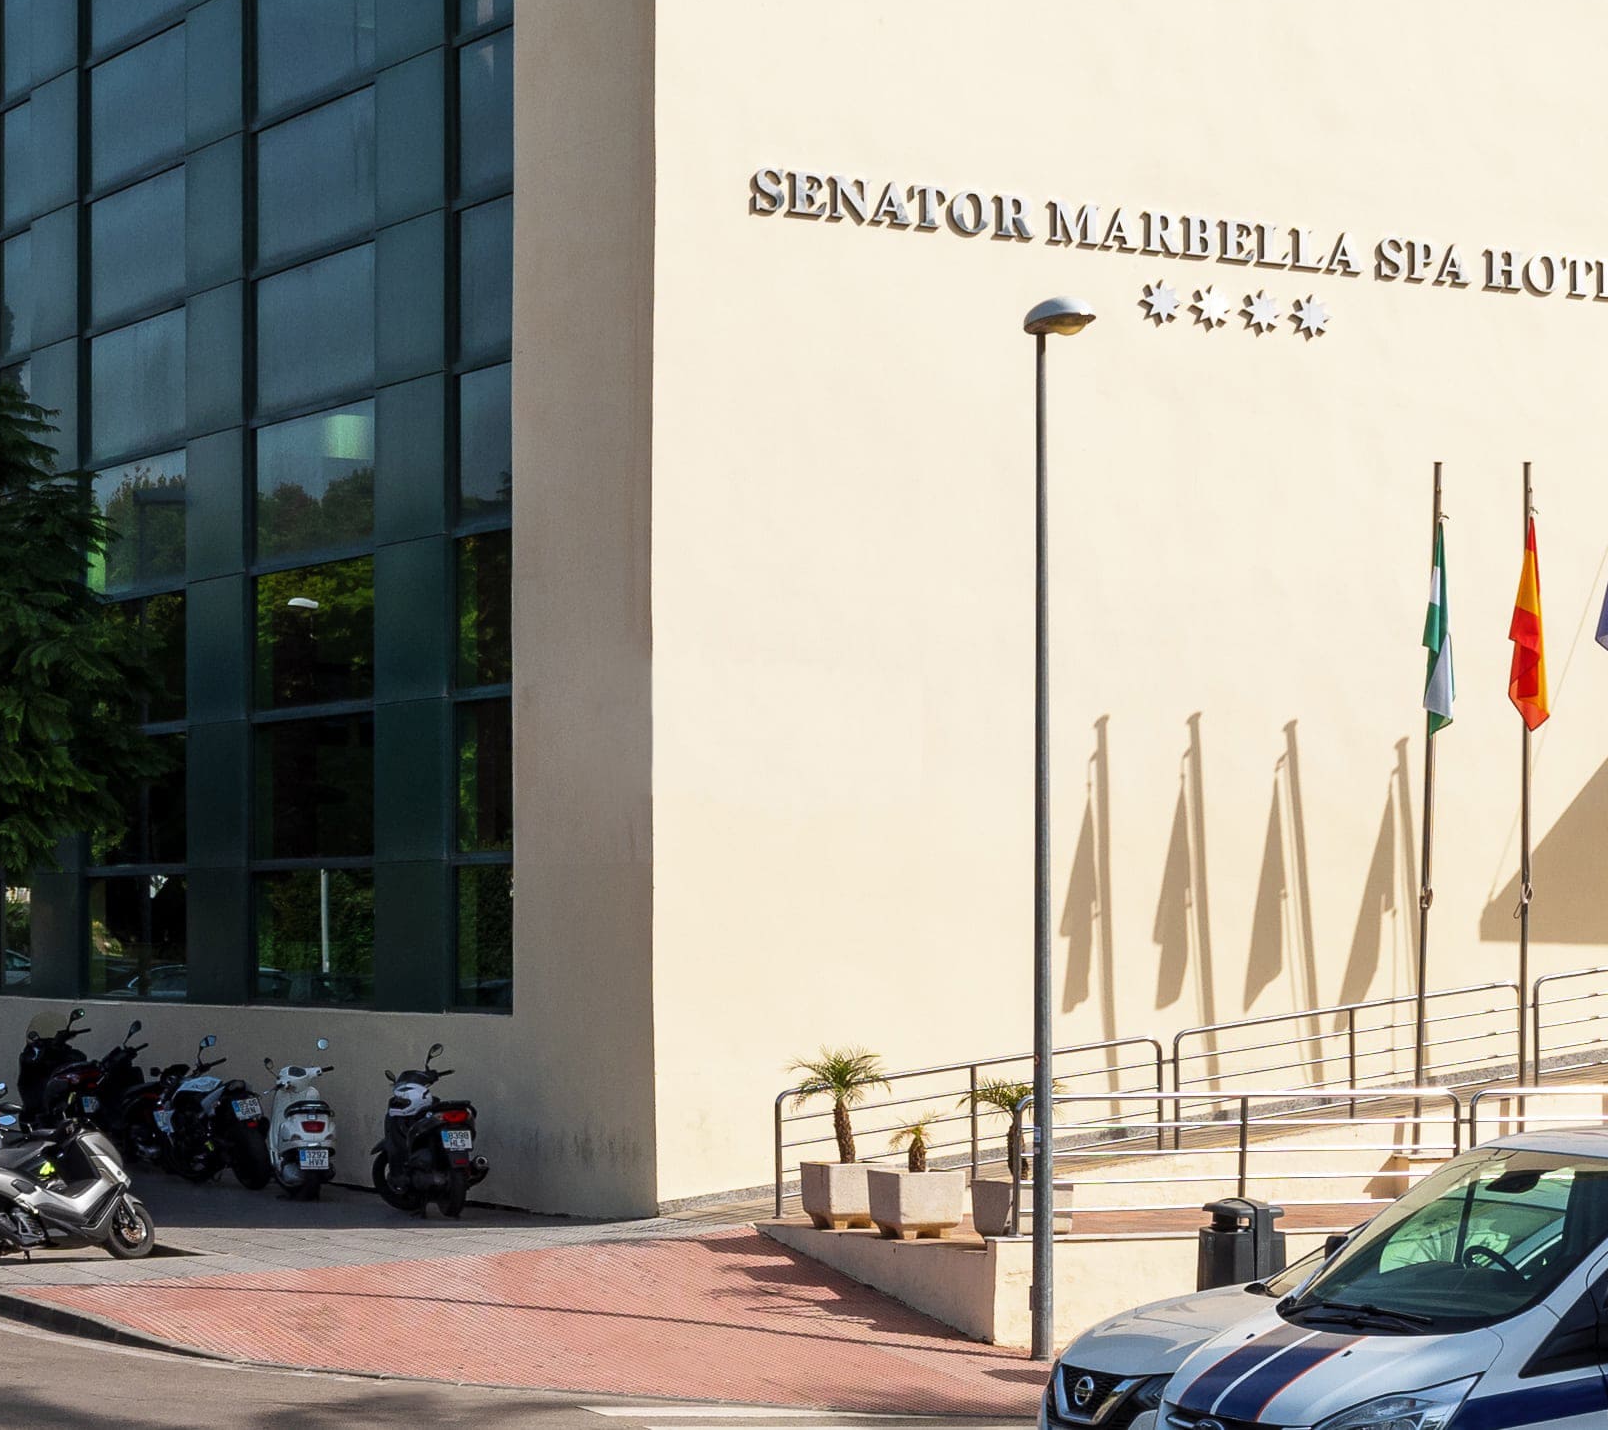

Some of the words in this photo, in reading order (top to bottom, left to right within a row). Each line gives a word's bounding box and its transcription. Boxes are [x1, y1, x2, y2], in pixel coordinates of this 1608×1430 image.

[749, 166, 1034, 243] SENATOR
[1045, 199, 1362, 278] MARBELLA
[1374, 237, 1471, 290] SPA
